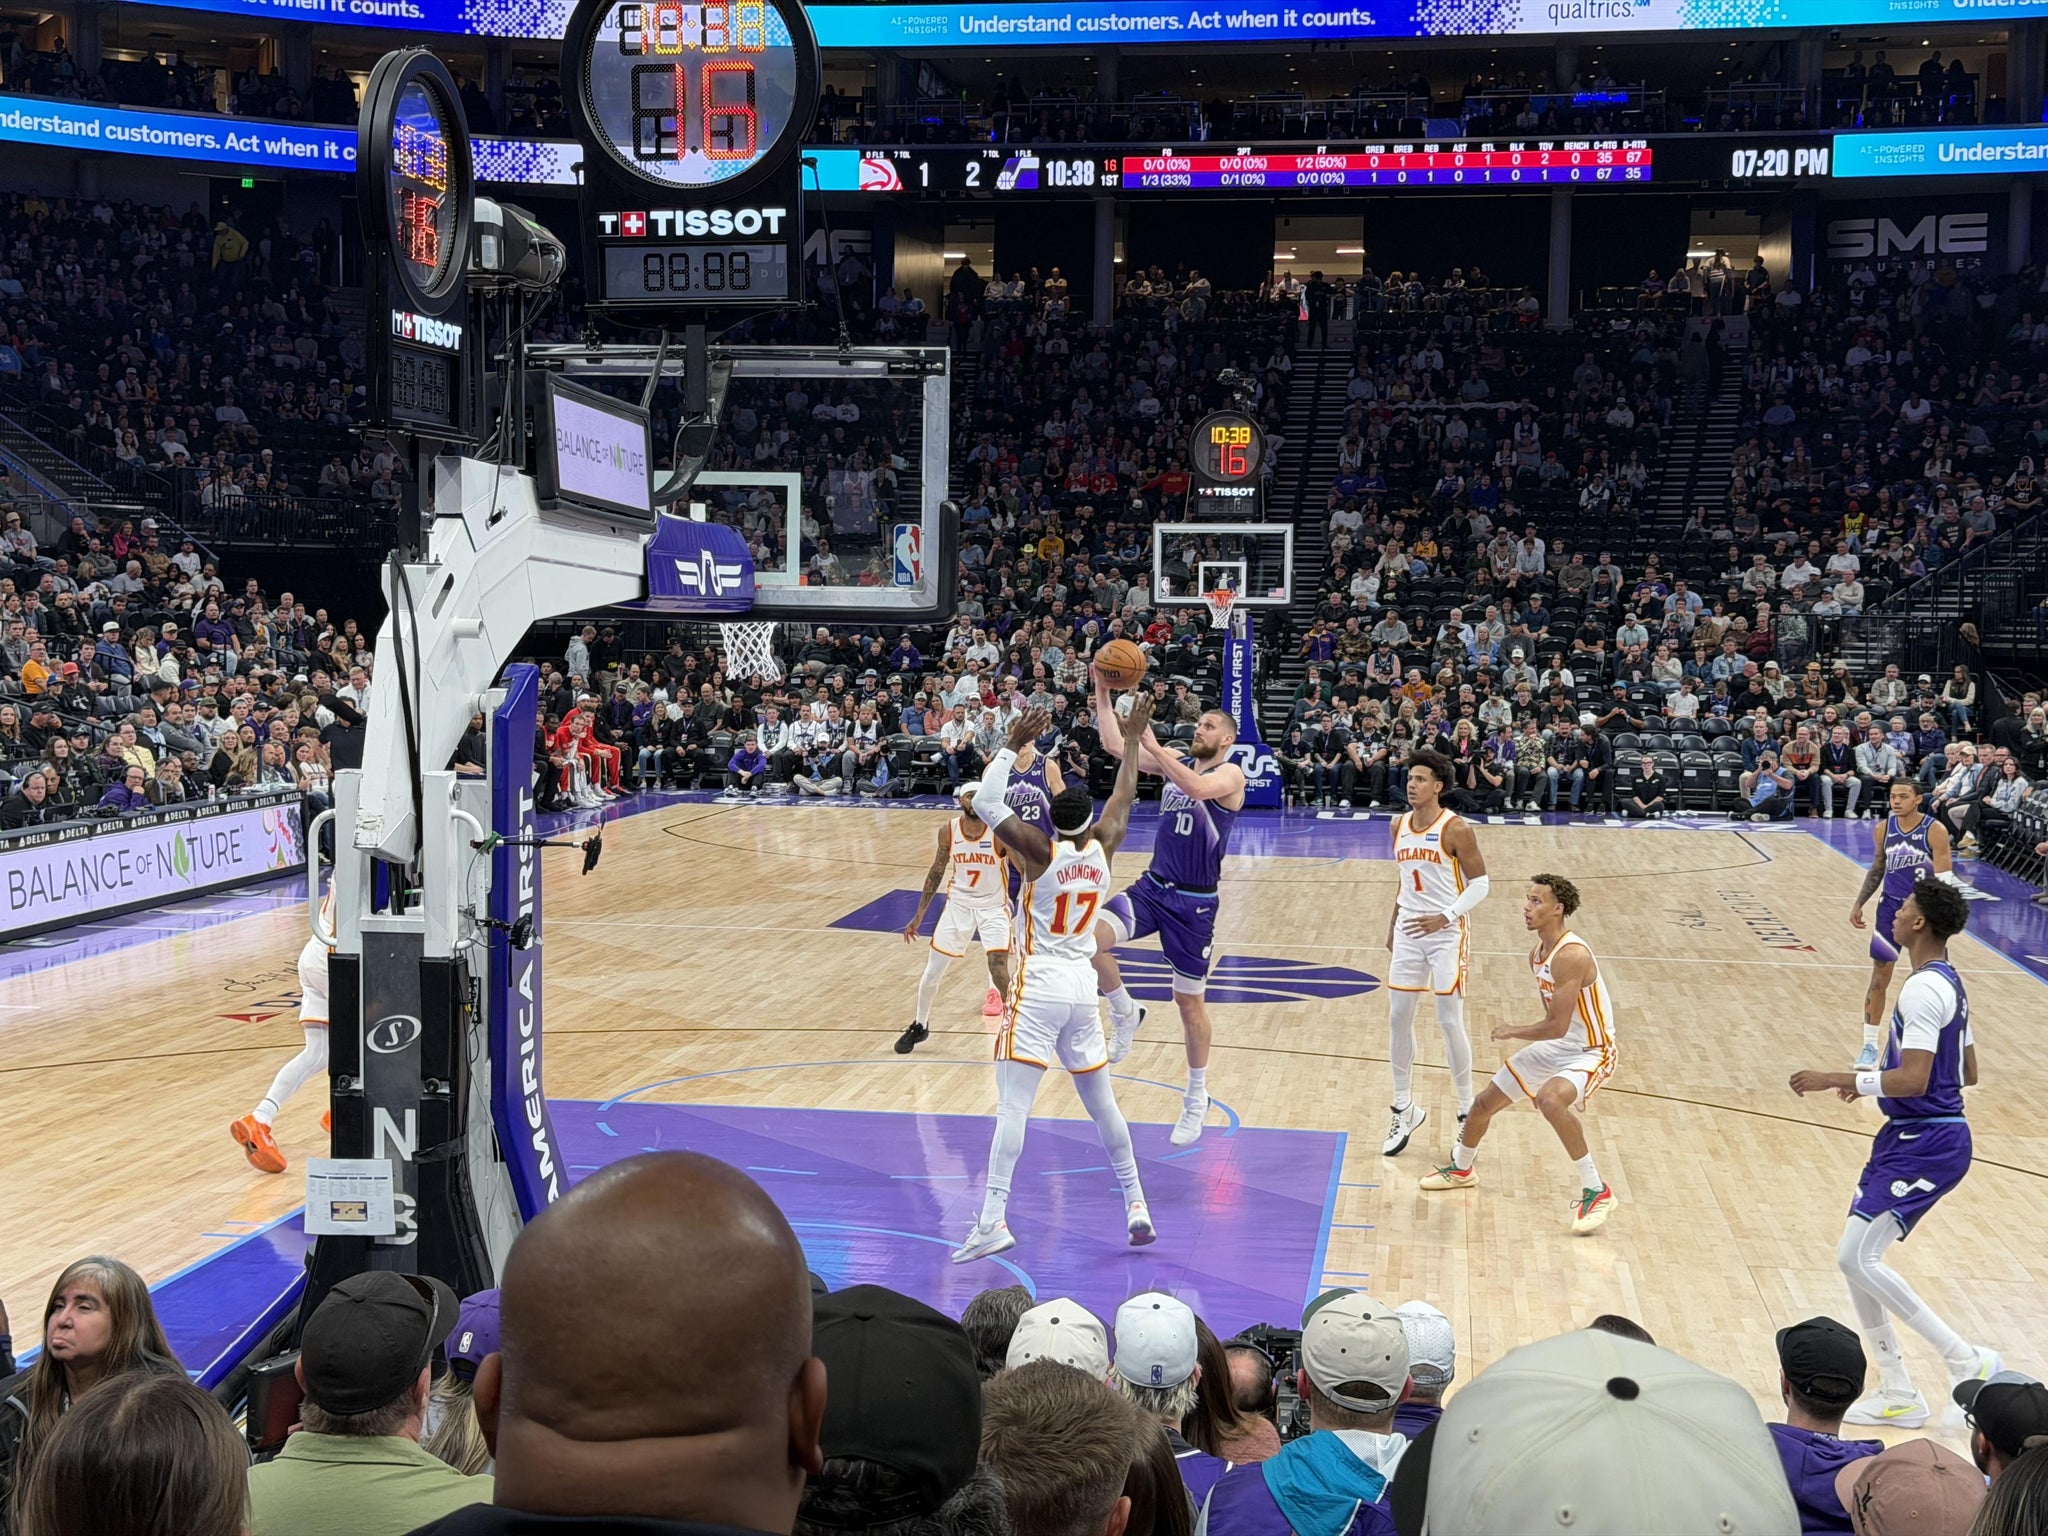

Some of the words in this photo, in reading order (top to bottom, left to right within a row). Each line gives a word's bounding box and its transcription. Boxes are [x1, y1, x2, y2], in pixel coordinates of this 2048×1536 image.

[351, 0, 425, 18] counts.
[1548, 0, 1635, 26] qualtrics.
[1889, 0, 1940, 10] INSIGHTS
[890, 16, 948, 25] AI-POWERED
[959, 14, 1071, 34] Understand
[1076, 13, 1184, 31] customers.
[1187, 11, 1222, 29] Act
[1225, 9, 1278, 28] when
[1283, 8, 1298, 27] it
[1302, 7, 1376, 27] counts.
[903, 26, 948, 34] INSIGHTS
[0, 109, 100, 137] nderstand
[105, 125, 221, 149] customers.
[224, 132, 260, 153] Act
[264, 137, 319, 158] when
[324, 141, 338, 160] it
[872, 151, 884, 159] FLS
[894, 151, 898, 159] 7
[983, 150, 988, 158] 7
[1162, 148, 1172, 157] FG
[1237, 147, 1251, 156] 3PT
[1317, 146, 1326, 155] FT
[1424, 144, 1439, 153] REB
[1452, 143, 1467, 152] AST
[1481, 143, 1495, 152] STL
[1509, 142, 1525, 151] BLK
[1538, 142, 1554, 151] TOV
[1564, 141, 1590, 150] BENCH
[1860, 144, 1925, 154] AI-POWERED
[1938, 141, 2048, 162] Understan
[1104, 159, 1117, 172] 16
[1143, 158, 1165, 171] 0/0
[1167, 158, 1191, 171] (0%)
[1219, 157, 1241, 170] 0/0
[1243, 157, 1267, 170] (0%)
[1296, 156, 1314, 169] 1/2
[1315, 156, 1347, 169] (50%)
[1370, 156, 1379, 168] 0
[1399, 155, 1406, 167] 1
[1427, 155, 1434, 167] 1
[1454, 154, 1464, 166] 0
[1484, 154, 1491, 166] 1
[1512, 153, 1521, 165] 0
[1541, 153, 1549, 165] 2
[1571, 152, 1580, 164] 0
[1597, 152, 1613, 163] 35
[1626, 151, 1642, 163] 67
[1732, 149, 1789, 177] 07:20
[1794, 148, 1828, 176] PM
[1874, 154, 1925, 164] INSIGHTS
[919, 162, 928, 187] 1
[965, 162, 980, 187] 2
[1046, 160, 1095, 187] 10:38
[1101, 175, 1119, 186] 1ST
[1141, 174, 1159, 187] 1/3
[1160, 174, 1191, 187] (33%)
[1221, 173, 1240, 185] 0/1
[1241, 173, 1266, 185] (0%)
[1297, 172, 1319, 184] 0/0
[1320, 172, 1345, 184] (0%)
[1371, 172, 1377, 183] 1
[1398, 171, 1407, 183] 0
[1427, 170, 1433, 182] 1
[1454, 170, 1463, 182] 0
[1484, 170, 1490, 181] 1
[1511, 169, 1520, 181] 0
[1541, 169, 1547, 180] 1
[1571, 168, 1580, 180] 0
[1596, 168, 1612, 179] 67
[1625, 167, 1641, 179] 35
[650, 208, 786, 236] TISSOT
[1827, 213, 1989, 258] SME
[414, 315, 462, 350] TISSOT
[1211, 426, 1251, 444] 10:38
[556, 428, 602, 464] BALANCE
[602, 446, 609, 460] OF
[1220, 444, 1247, 475] 16
[1213, 487, 1255, 497] TISSOT
[897, 572, 911, 583] NBA
[1232, 642, 1243, 677] FIRST
[1245, 779, 1272, 787] FIRST
[231, 800, 248, 810] DELTA
[259, 796, 276, 806] DELTA
[170, 810, 189, 820] DELTA
[202, 805, 220, 816] DELTA
[1021, 806, 1040, 820] 23
[103, 820, 124, 832] DELTA
[137, 815, 157, 826] DELTA
[1174, 811, 1194, 836] 10
[26, 833, 50, 847] DELTA
[66, 826, 89, 838] DELTA
[953, 852, 996, 865] ATLANTA
[1887, 852, 1926, 874] UTAH
[519, 786, 534, 950] IRST
[1056, 864, 1103, 885] OKONGWU
[8, 849, 133, 911] BALANCE
[136, 853, 152, 875] OF
[966, 870, 981, 888] 7
[1412, 868, 1423, 891] 1
[1050, 891, 1099, 936] 17
[520, 959, 559, 1204] AMERICA
